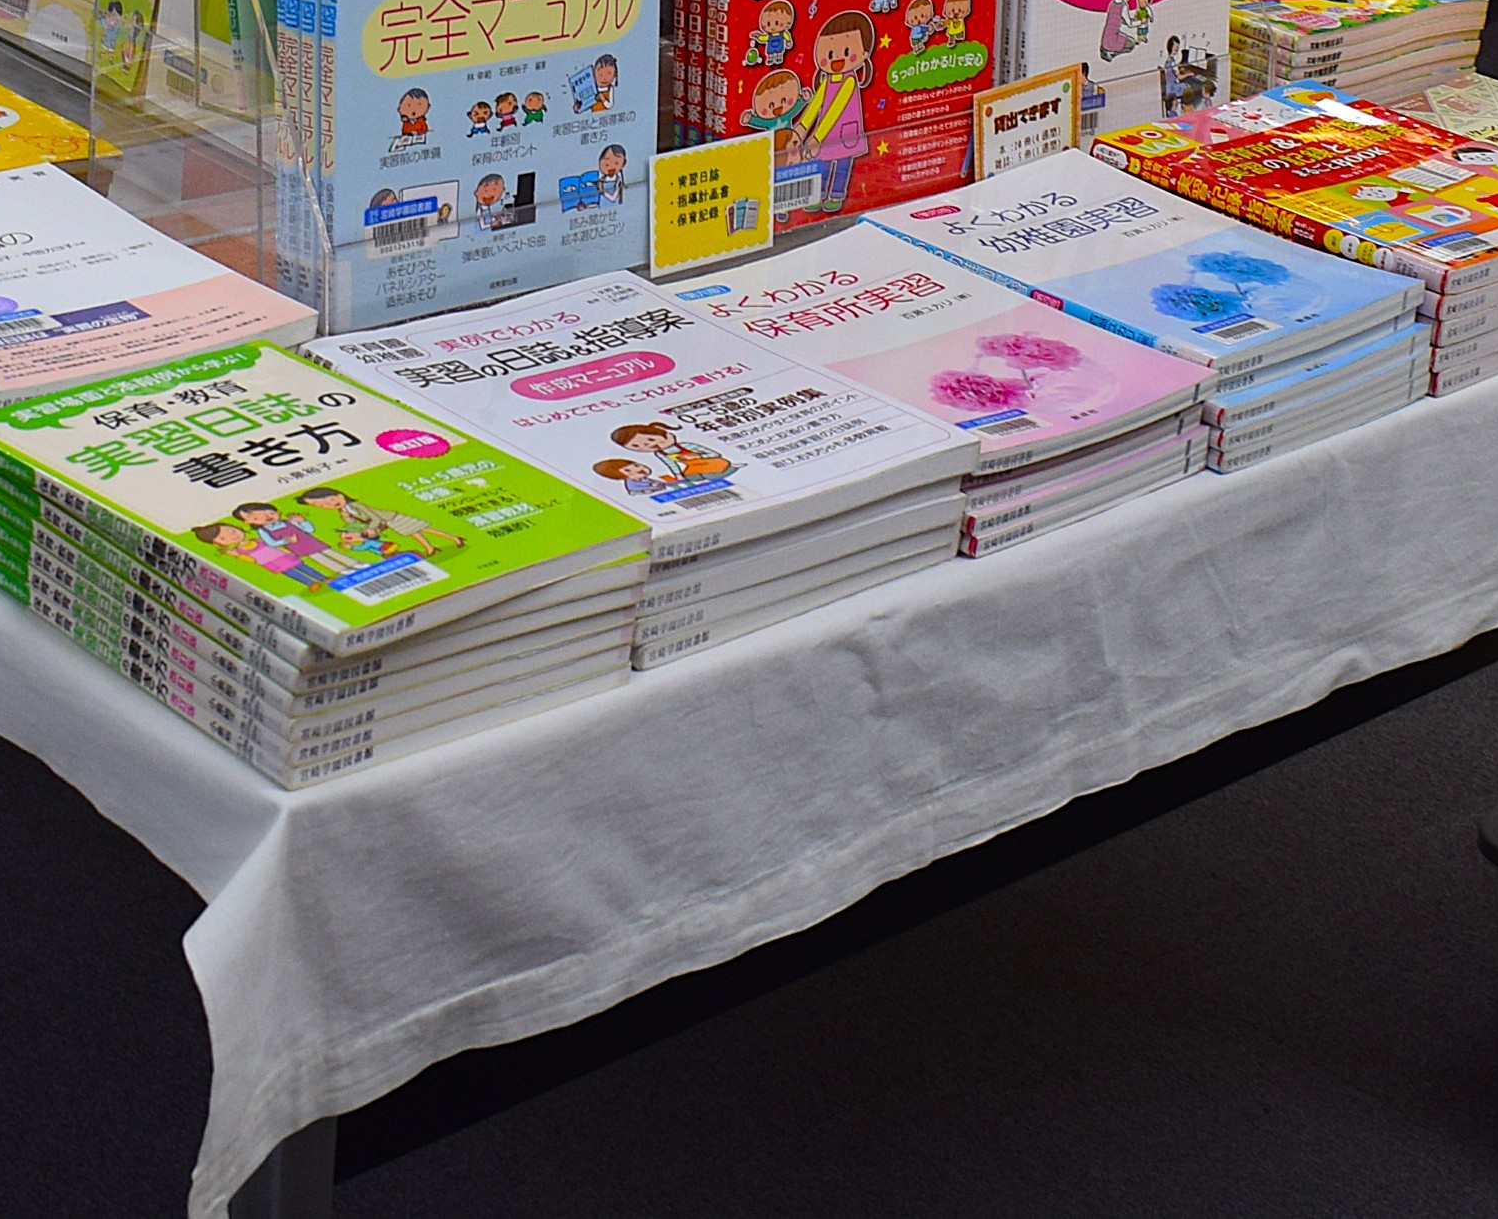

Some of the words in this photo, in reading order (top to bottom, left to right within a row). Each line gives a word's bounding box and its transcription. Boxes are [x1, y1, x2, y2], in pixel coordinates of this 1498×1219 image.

[553, 111, 636, 137] 実習日誌と指導案の
[581, 132, 608, 145] 書き方
[380, 146, 441, 169] 実習前の準備
[472, 144, 537, 166] 保育のポイント
[677, 168, 720, 189] 実習日誌
[677, 185, 729, 208] 指導計画書
[677, 206, 719, 227] 保育記録
[947, 190, 1078, 236] よくわかる
[979, 197, 1159, 255] 幼稚園実習
[709, 269, 858, 318] よくわかる
[743, 271, 945, 339] 保育所実習
[394, 308, 696, 391] 実習の日誌&指導案
[436, 308, 582, 355] 実例でわかる
[527, 356, 655, 398] 作成マニュアル
[93, 380, 248, 430] 保育・教育
[66, 391, 357, 481] 実習日誌の
[172, 416, 363, 492] 書き方
